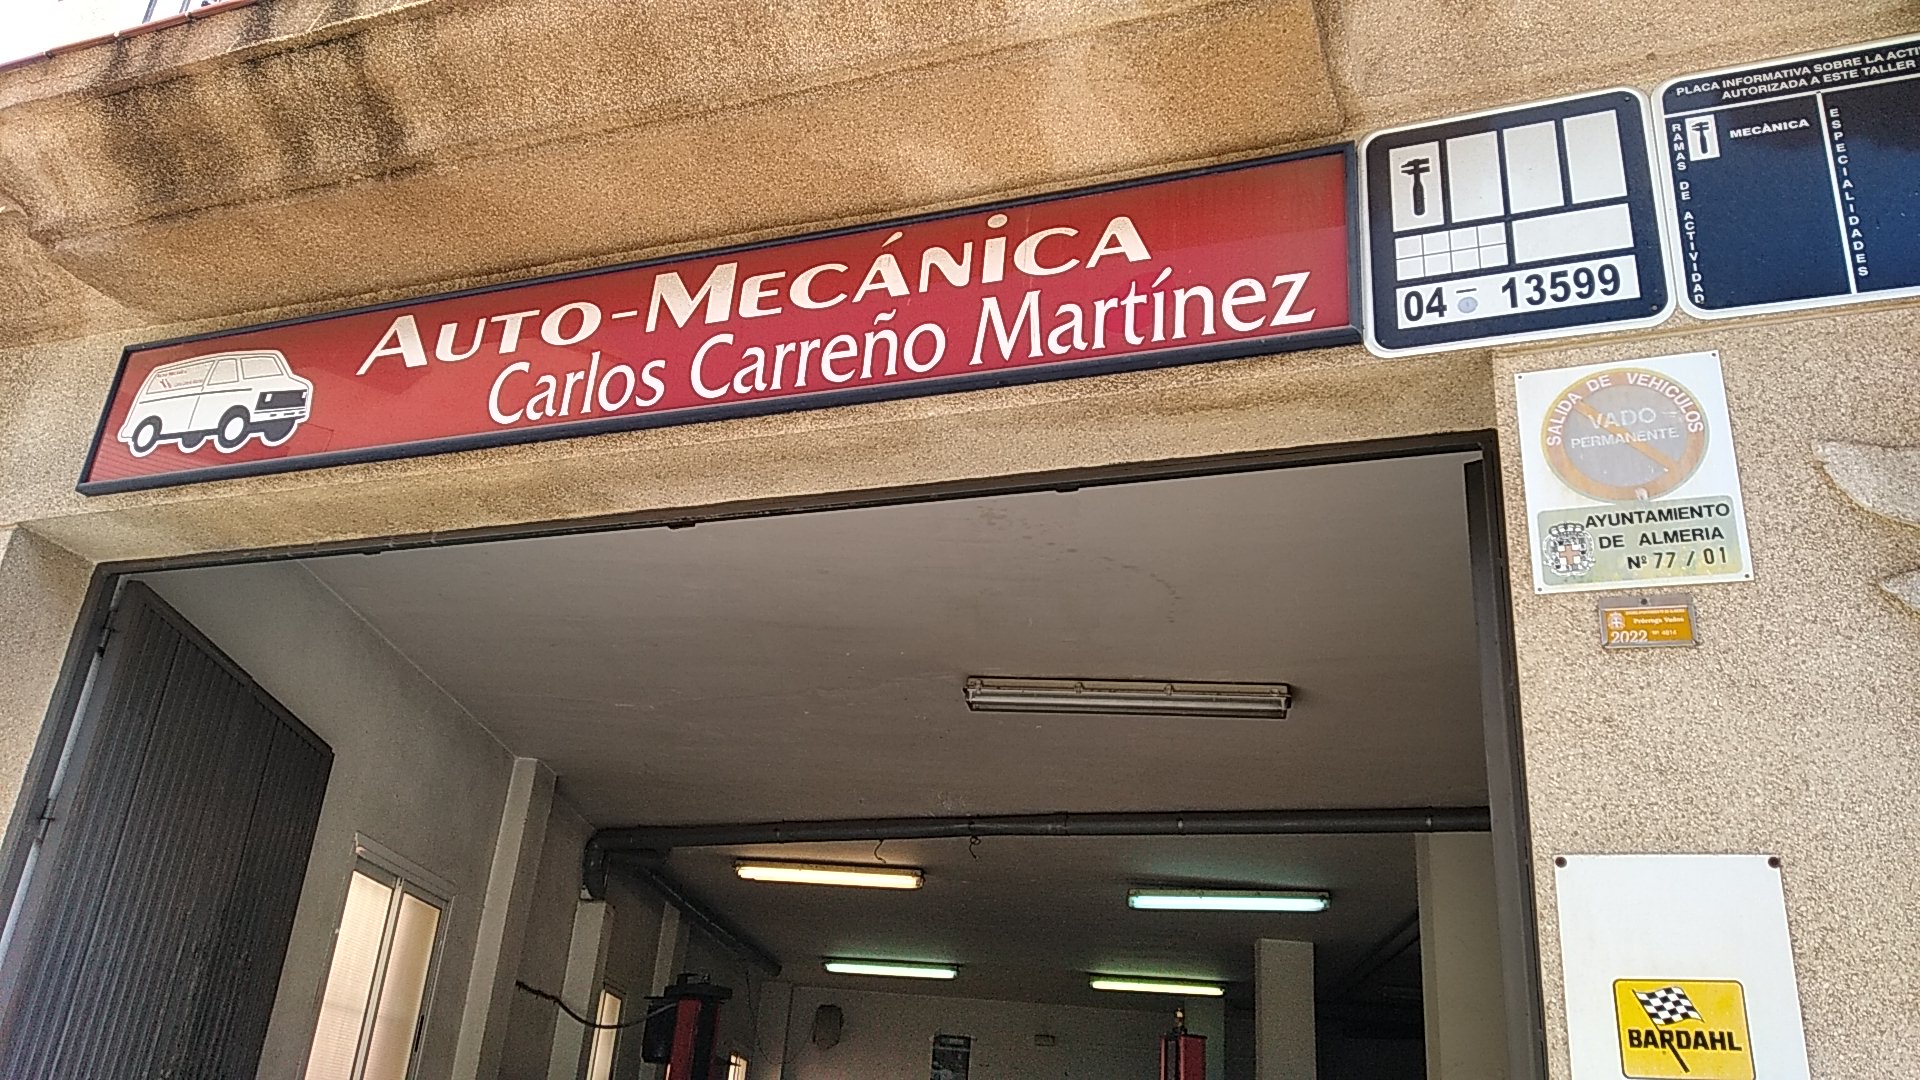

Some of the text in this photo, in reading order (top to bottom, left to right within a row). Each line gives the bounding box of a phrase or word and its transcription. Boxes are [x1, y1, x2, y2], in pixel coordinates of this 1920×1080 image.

[1676, 46, 1920, 96] PLACA INFORMATIVA SOBRE LA ACTI
[1721, 59, 1917, 100] AUTORIZADA A ESTE TALLER
[1829, 108, 1869, 277] ESPECIALIDADES
[1672, 123, 1705, 304] RAMAS DE ACTIVIDAD
[1404, 287, 1447, 322] 04
[1501, 263, 1621, 309] 13599
[488, 266, 1317, 425] Carlos Carreño Martínez
[1546, 372, 1704, 446] SALIDA DE VEHICULOS
[1588, 407, 1656, 430] VADO
[1570, 426, 1680, 449] PERMANENTE
[1585, 503, 1730, 528] AYUNTAMIENTO
[1599, 527, 1725, 549] DE ALMERIA
[1703, 547, 1726, 564] 01
[1611, 629, 1648, 643] 2022
[1628, 1029, 1742, 1051] BARDAHL
